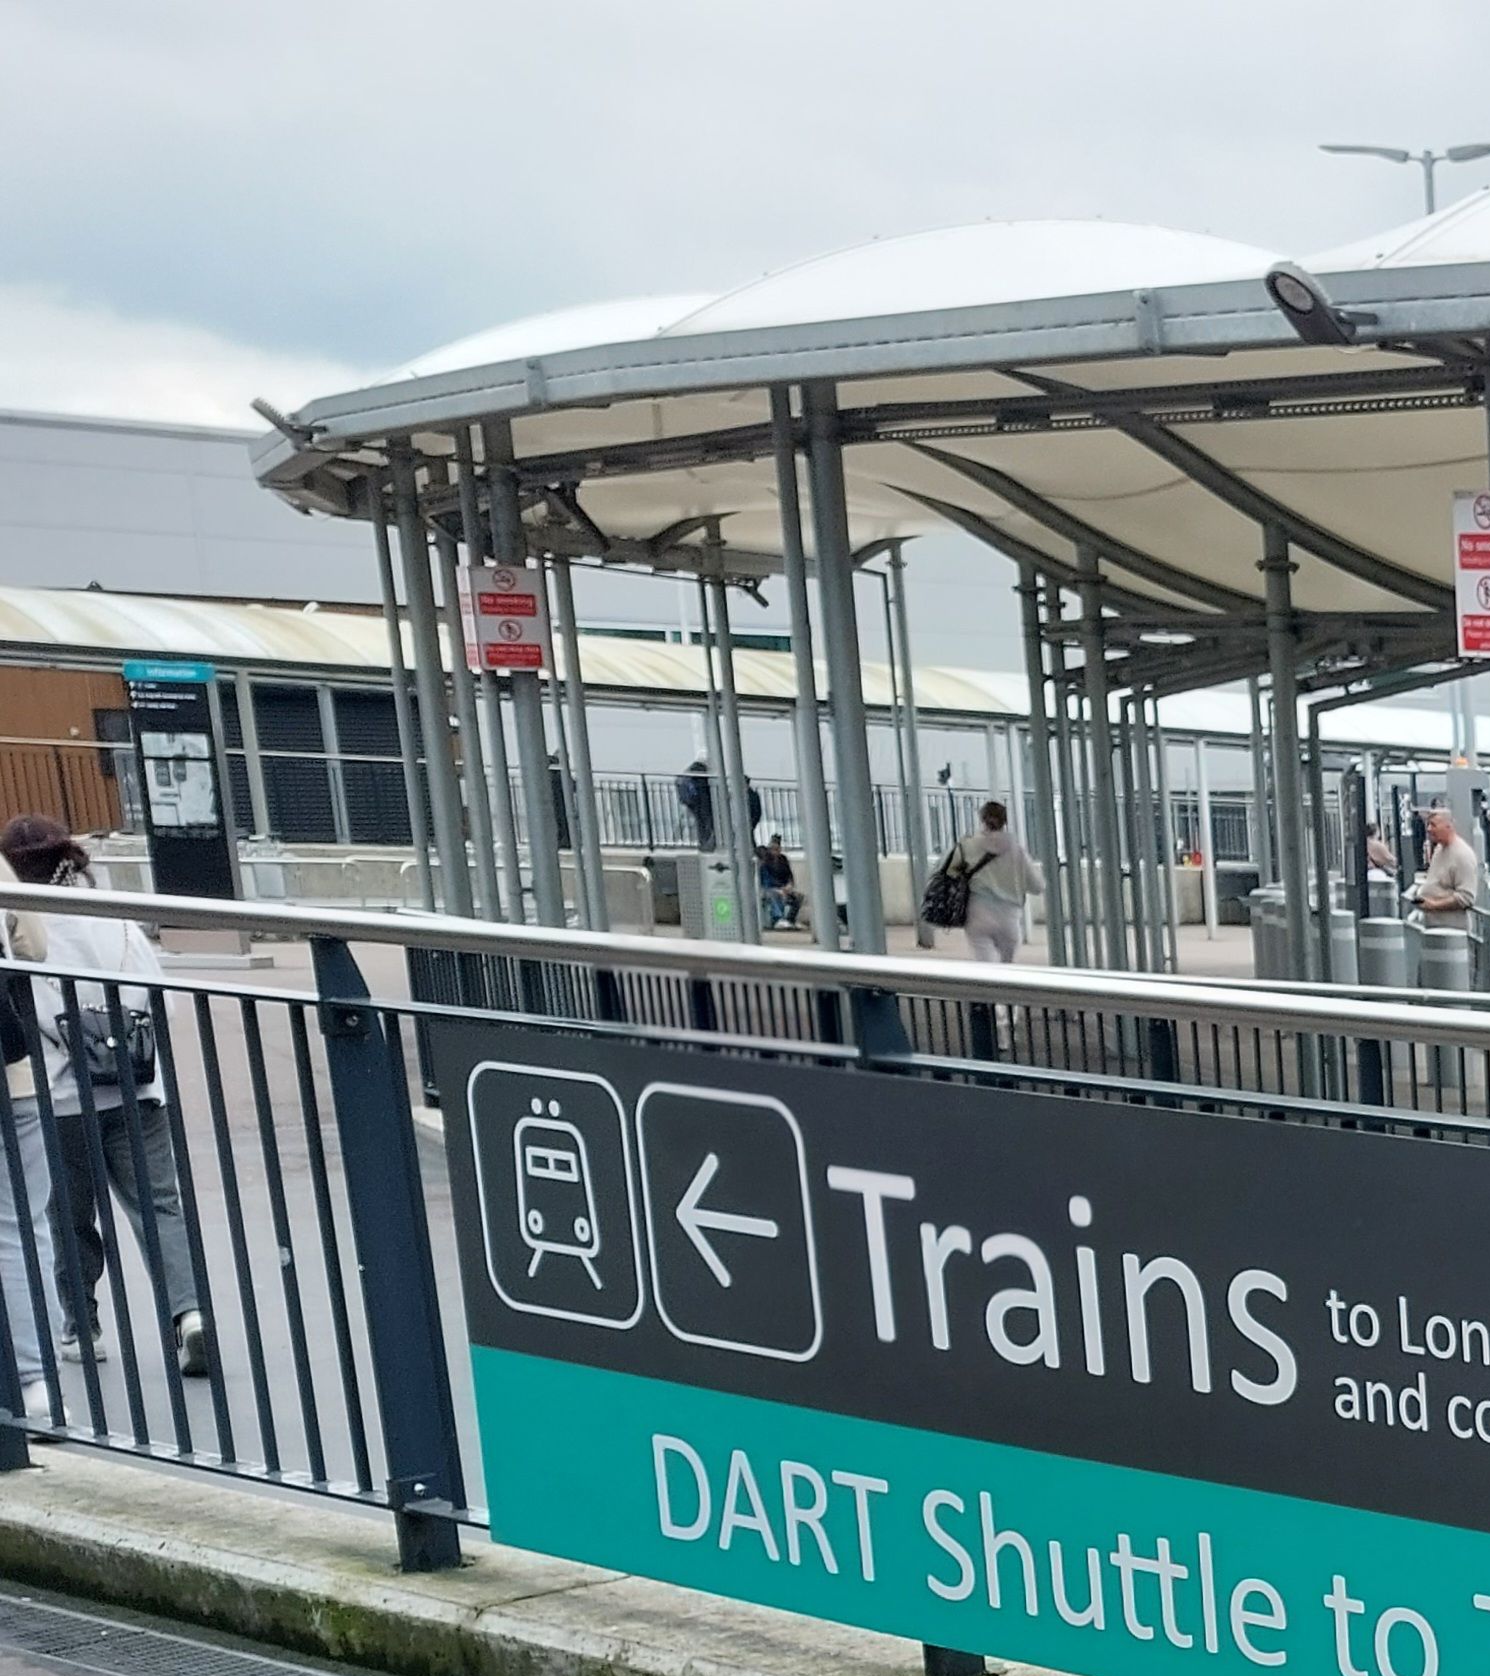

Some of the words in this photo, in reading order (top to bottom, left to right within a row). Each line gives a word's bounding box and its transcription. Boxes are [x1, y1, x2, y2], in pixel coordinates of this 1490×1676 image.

[827, 1165, 1298, 1405] Trains
[1325, 1290, 1381, 1347] to
[1334, 1372, 1427, 1432] and
[653, 1433, 889, 1583] DART
[923, 1489, 1286, 1667] Shuttle
